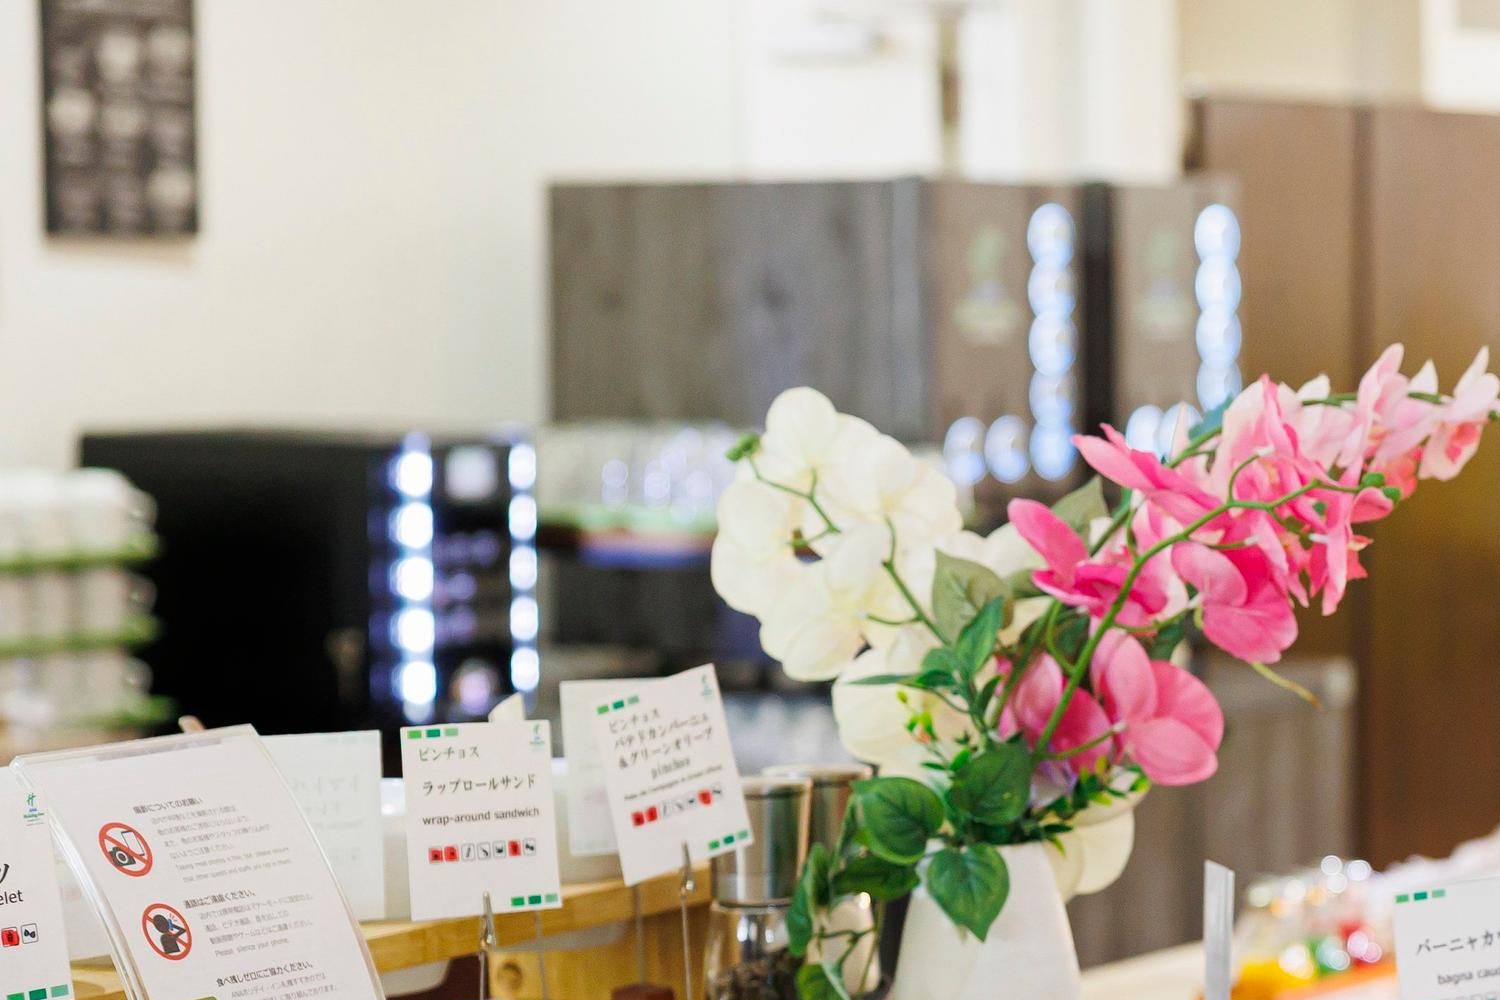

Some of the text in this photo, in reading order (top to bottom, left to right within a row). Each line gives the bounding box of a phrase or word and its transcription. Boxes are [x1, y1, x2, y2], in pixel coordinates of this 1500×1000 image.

[423, 773, 536, 796] ラップロールサンド
[423, 807, 540, 827] wrap-around sandwich
[1437, 971, 1473, 985] bagna
